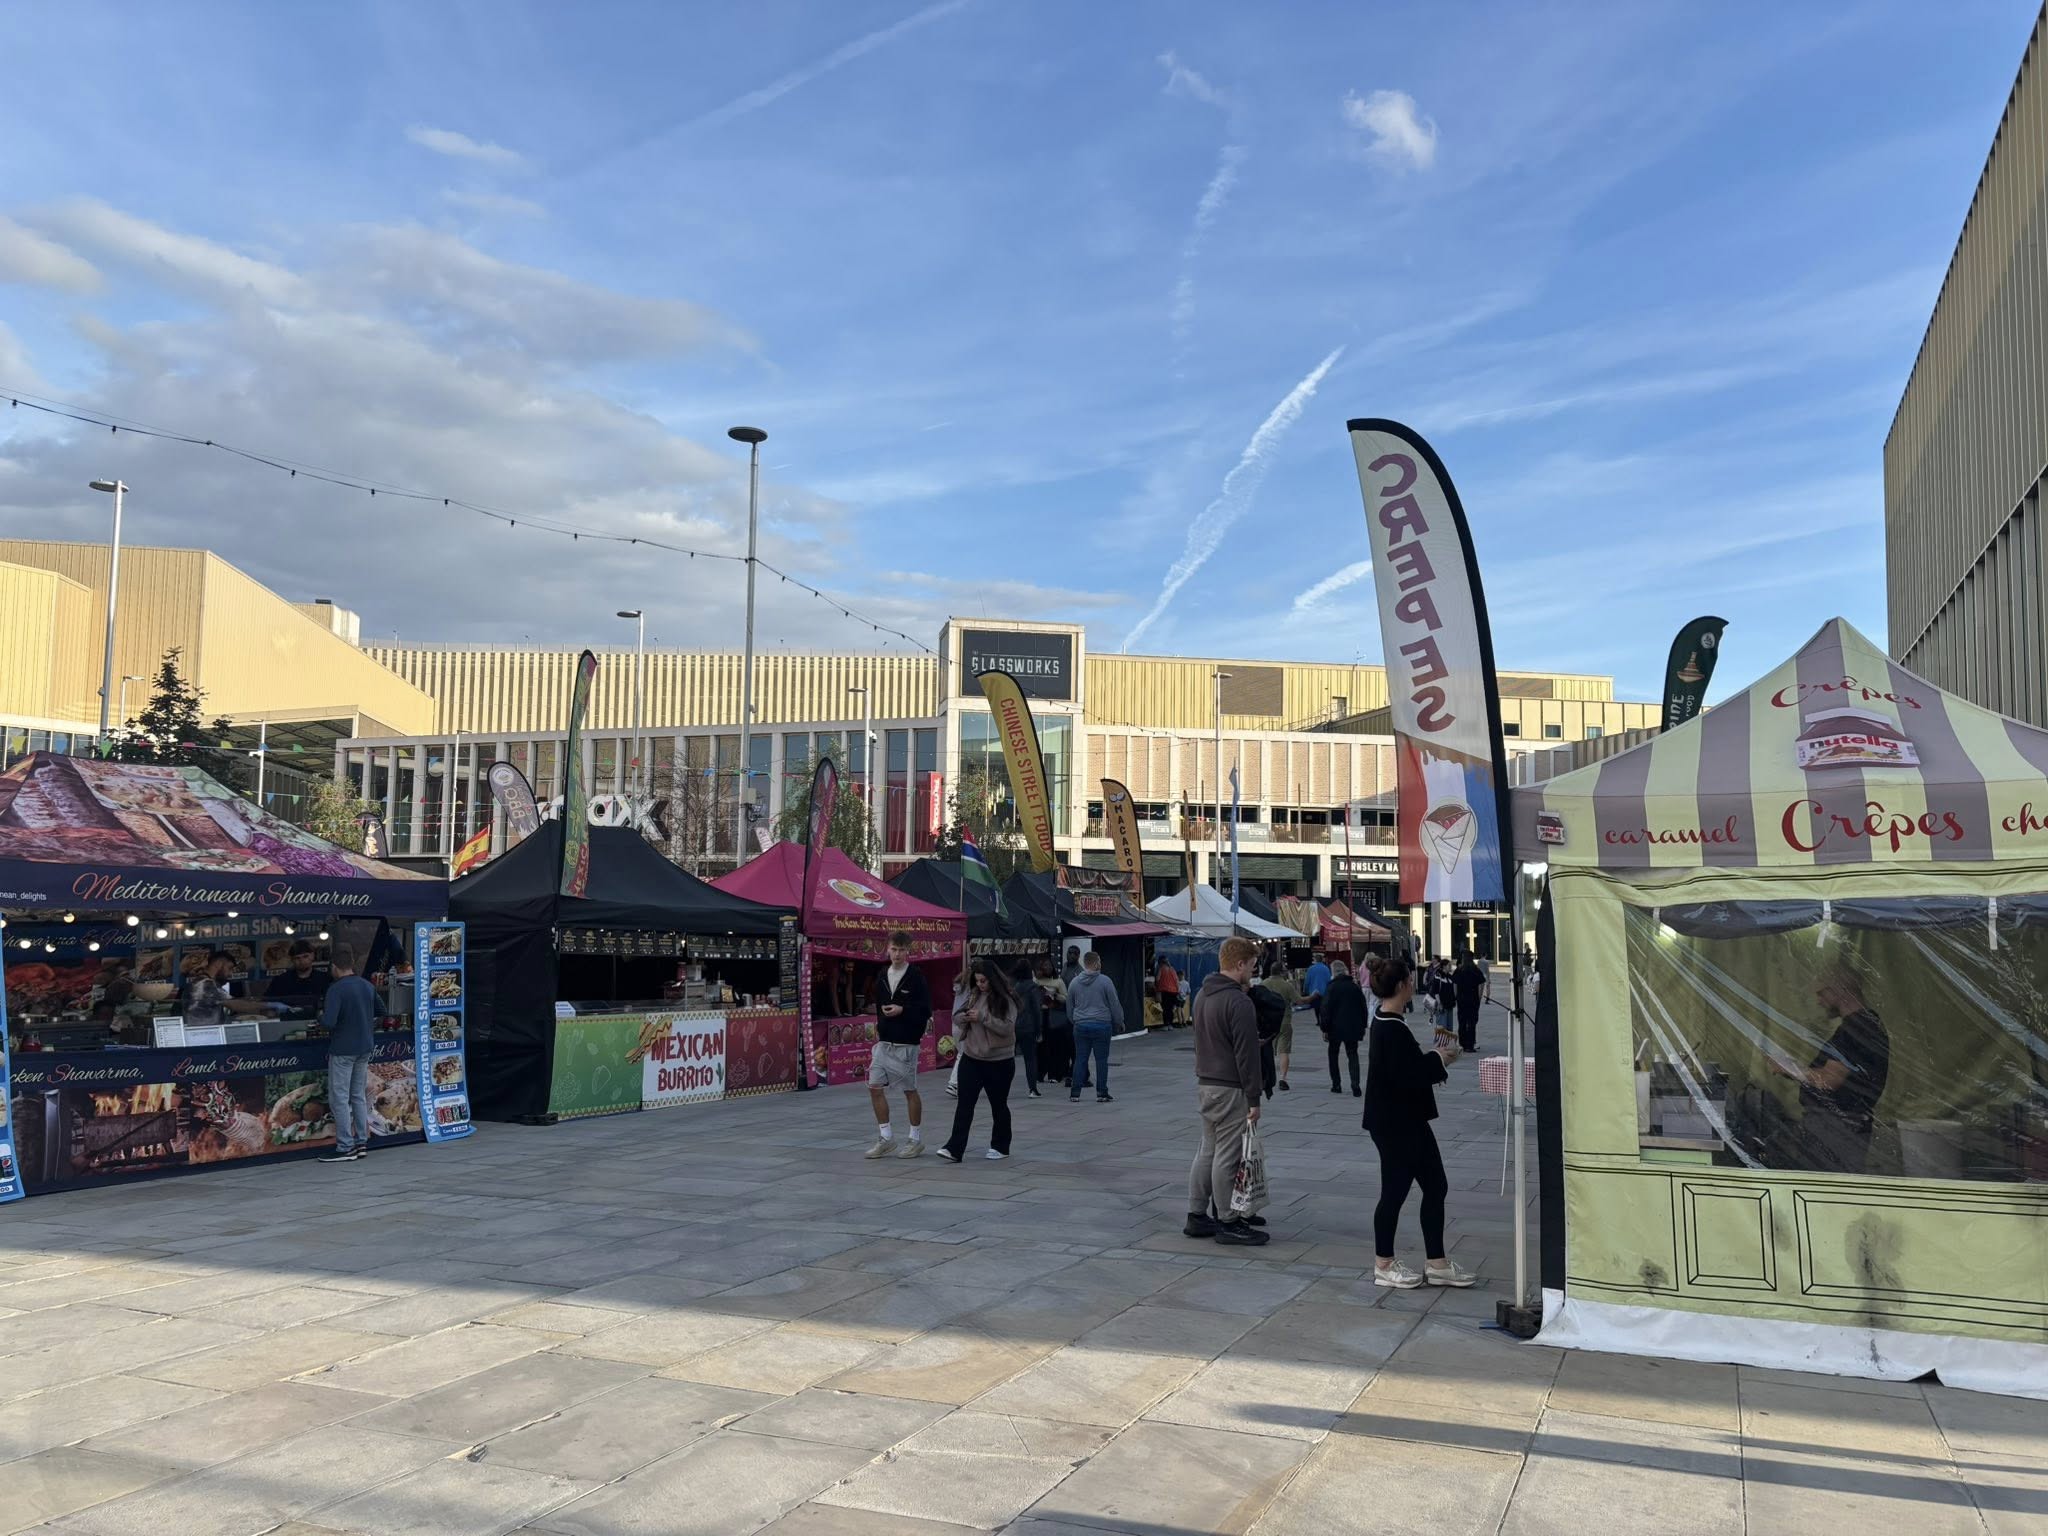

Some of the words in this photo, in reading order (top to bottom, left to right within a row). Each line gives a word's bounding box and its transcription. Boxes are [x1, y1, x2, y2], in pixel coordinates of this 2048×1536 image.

[971, 656, 1060, 675] GLASSWORKS
[1685, 695, 1695, 717] OOD
[1771, 676, 1922, 709] Crêpes
[1000, 697, 1029, 757] CHINESE
[1018, 757, 1042, 809] STREET
[1809, 735, 1899, 750] nutella
[1605, 815, 1740, 844] caramel
[1781, 799, 1964, 853] Crêpes
[1114, 804, 1139, 900] MACAROS
[72, 872, 255, 902] Mediterranean
[259, 882, 372, 907] Shawarma
[419, 939, 429, 1020] Shawarma
[652, 1029, 724, 1064] MEXICAN
[171, 1057, 217, 1078] Lamb
[220, 1055, 299, 1074] Shawarma
[421, 1024, 439, 1137] Mediterranean
[658, 1065, 713, 1091] BURRITO
